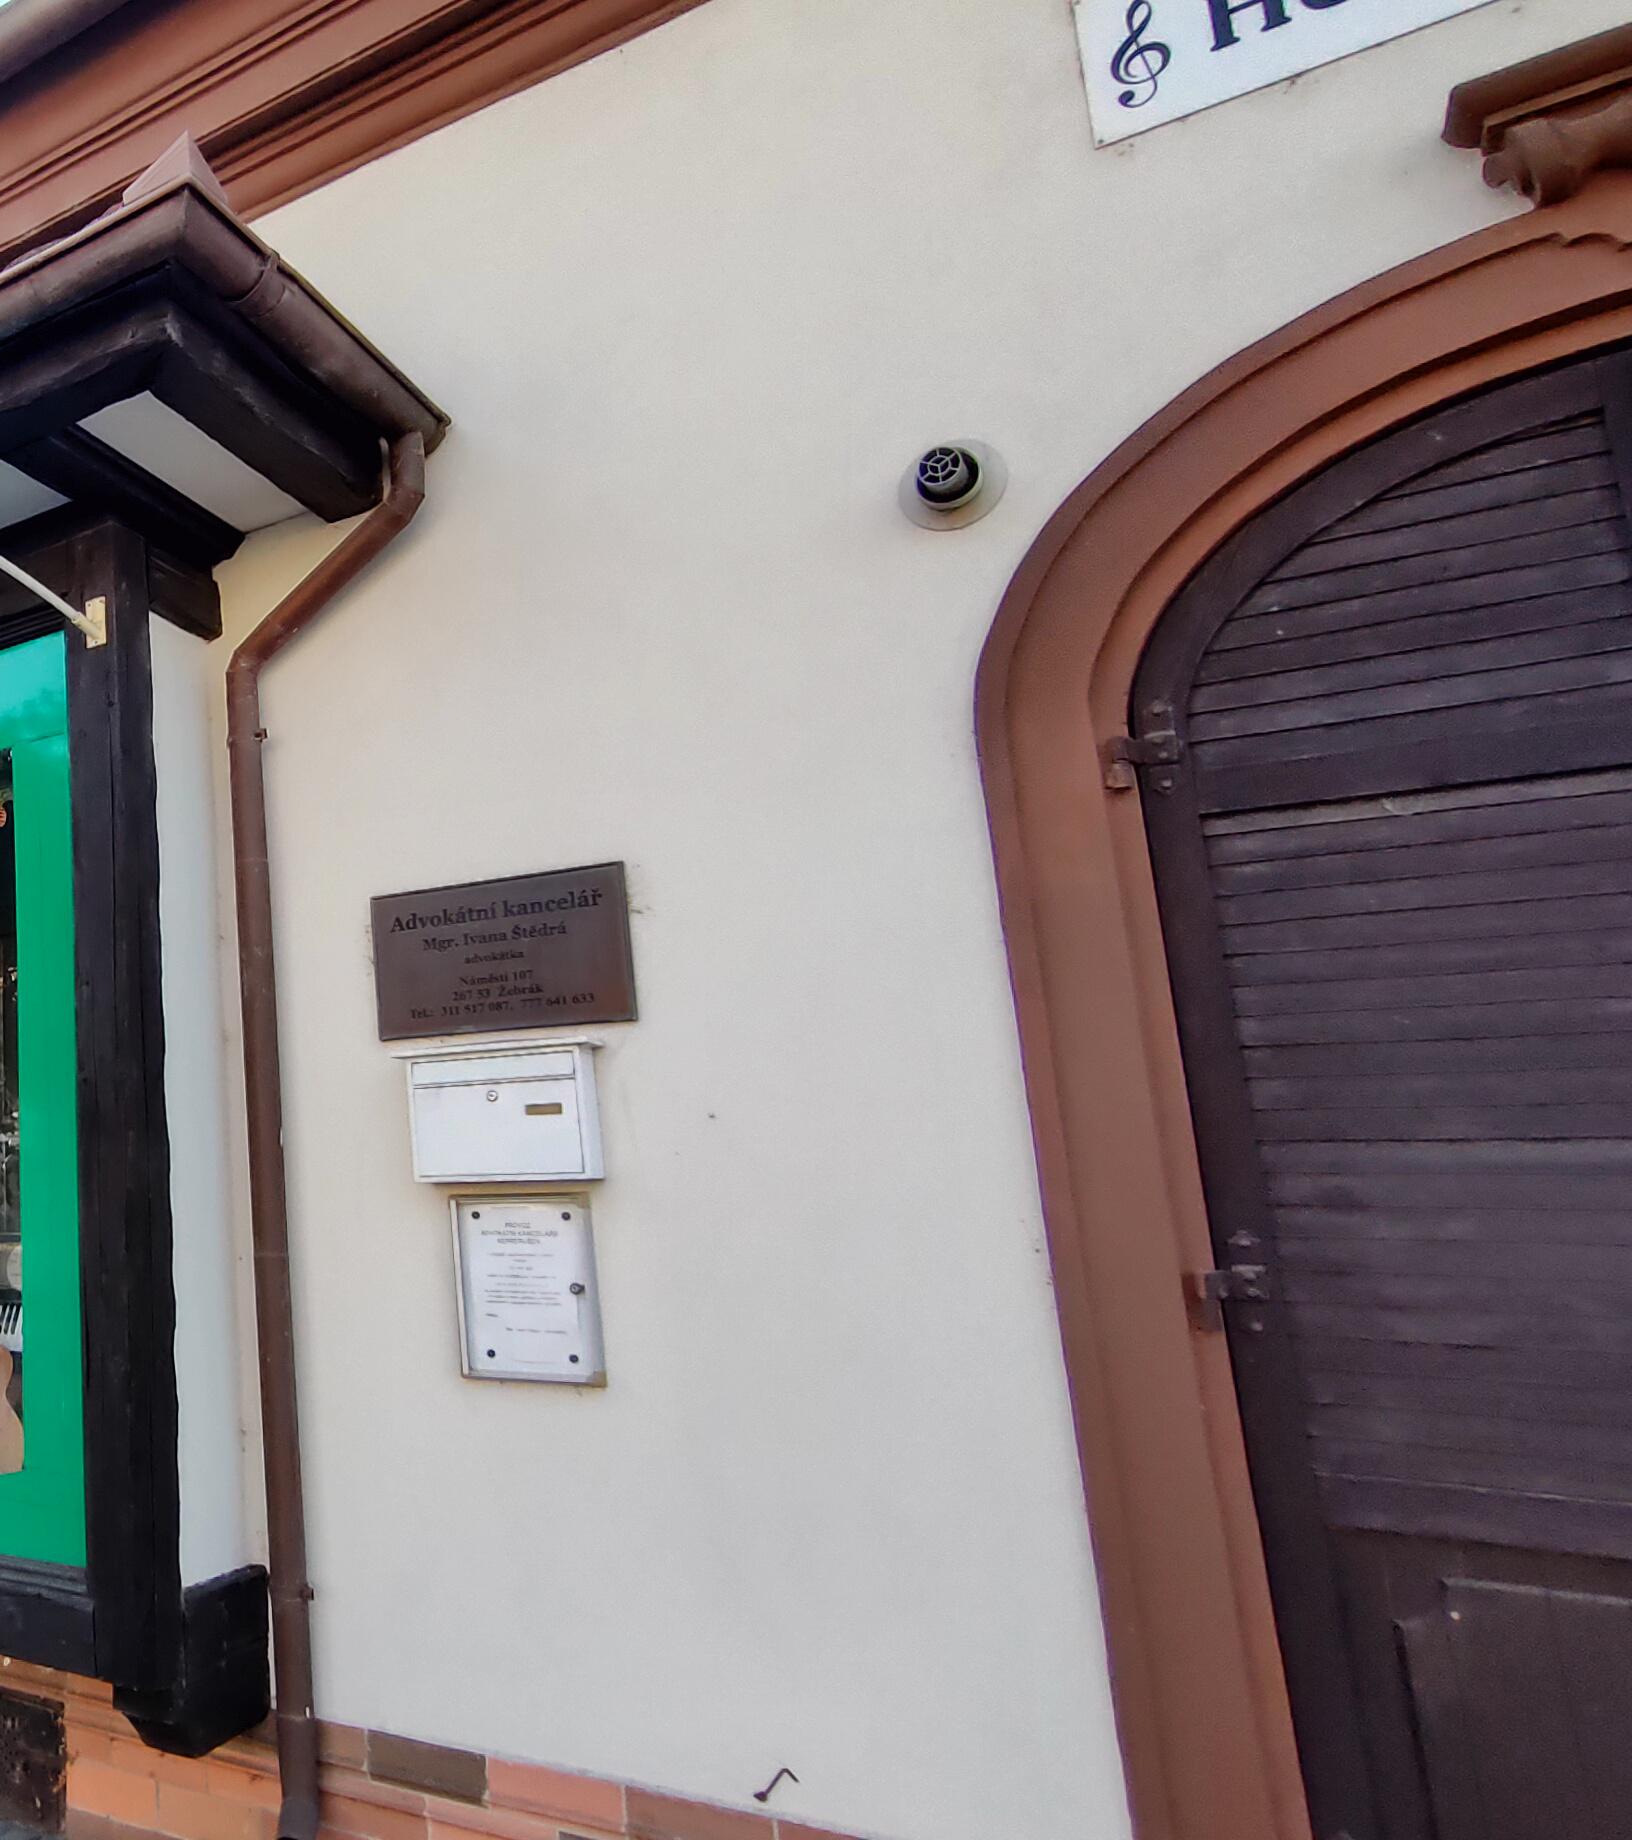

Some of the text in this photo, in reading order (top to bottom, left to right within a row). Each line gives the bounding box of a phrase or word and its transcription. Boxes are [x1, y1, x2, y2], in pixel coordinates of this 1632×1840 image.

[390, 888, 603, 933] Advokátní kancelář
[423, 922, 566, 952] Mgr. Ivana Štědrá
[513, 970, 533, 980] 107
